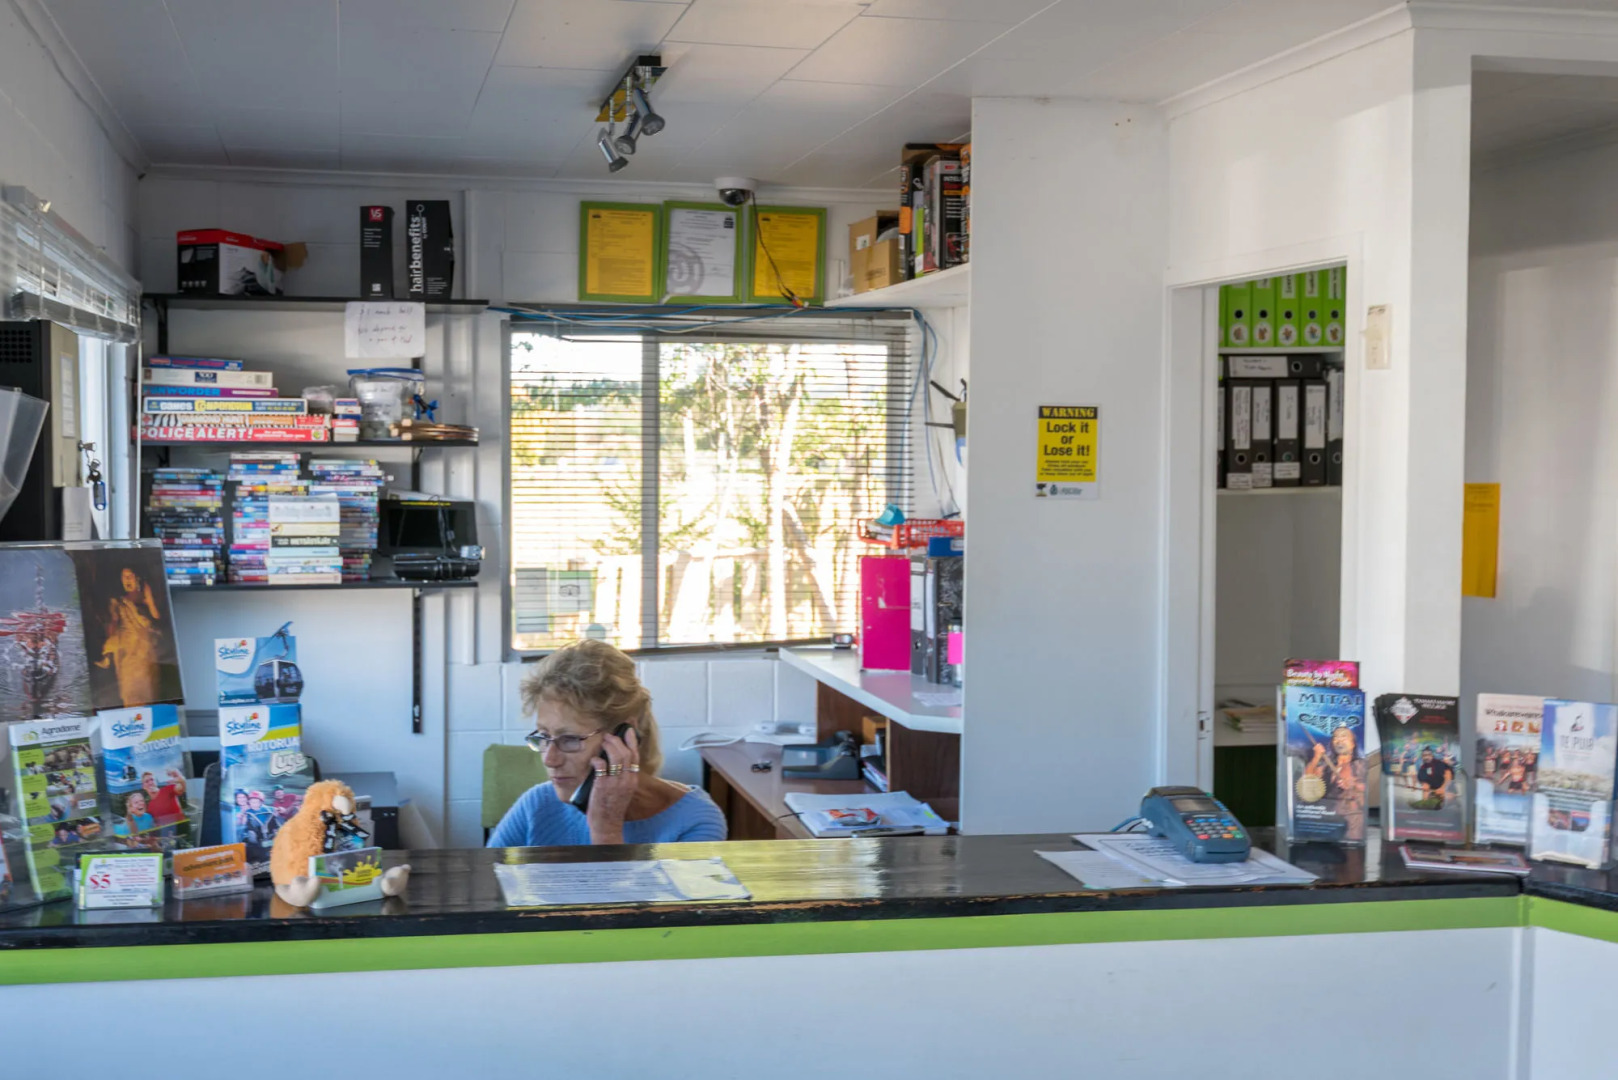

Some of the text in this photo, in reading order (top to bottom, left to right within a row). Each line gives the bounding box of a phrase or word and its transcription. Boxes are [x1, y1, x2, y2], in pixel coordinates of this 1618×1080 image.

[408, 214, 422, 292] hairbenefits
[1041, 407, 1095, 417] WARNING
[141, 426, 194, 440] POLICE
[195, 427, 254, 440] ALERT!
[1046, 421, 1089, 433] Lock it
[1060, 435, 1075, 444] or
[1043, 445, 1090, 456] Lose it!
[218, 642, 249, 658] Skyline
[1299, 693, 1363, 706] MITAI
[41, 724, 82, 735] Agrodome
[111, 719, 146, 737] Skyline
[225, 717, 262, 734] Skyline
